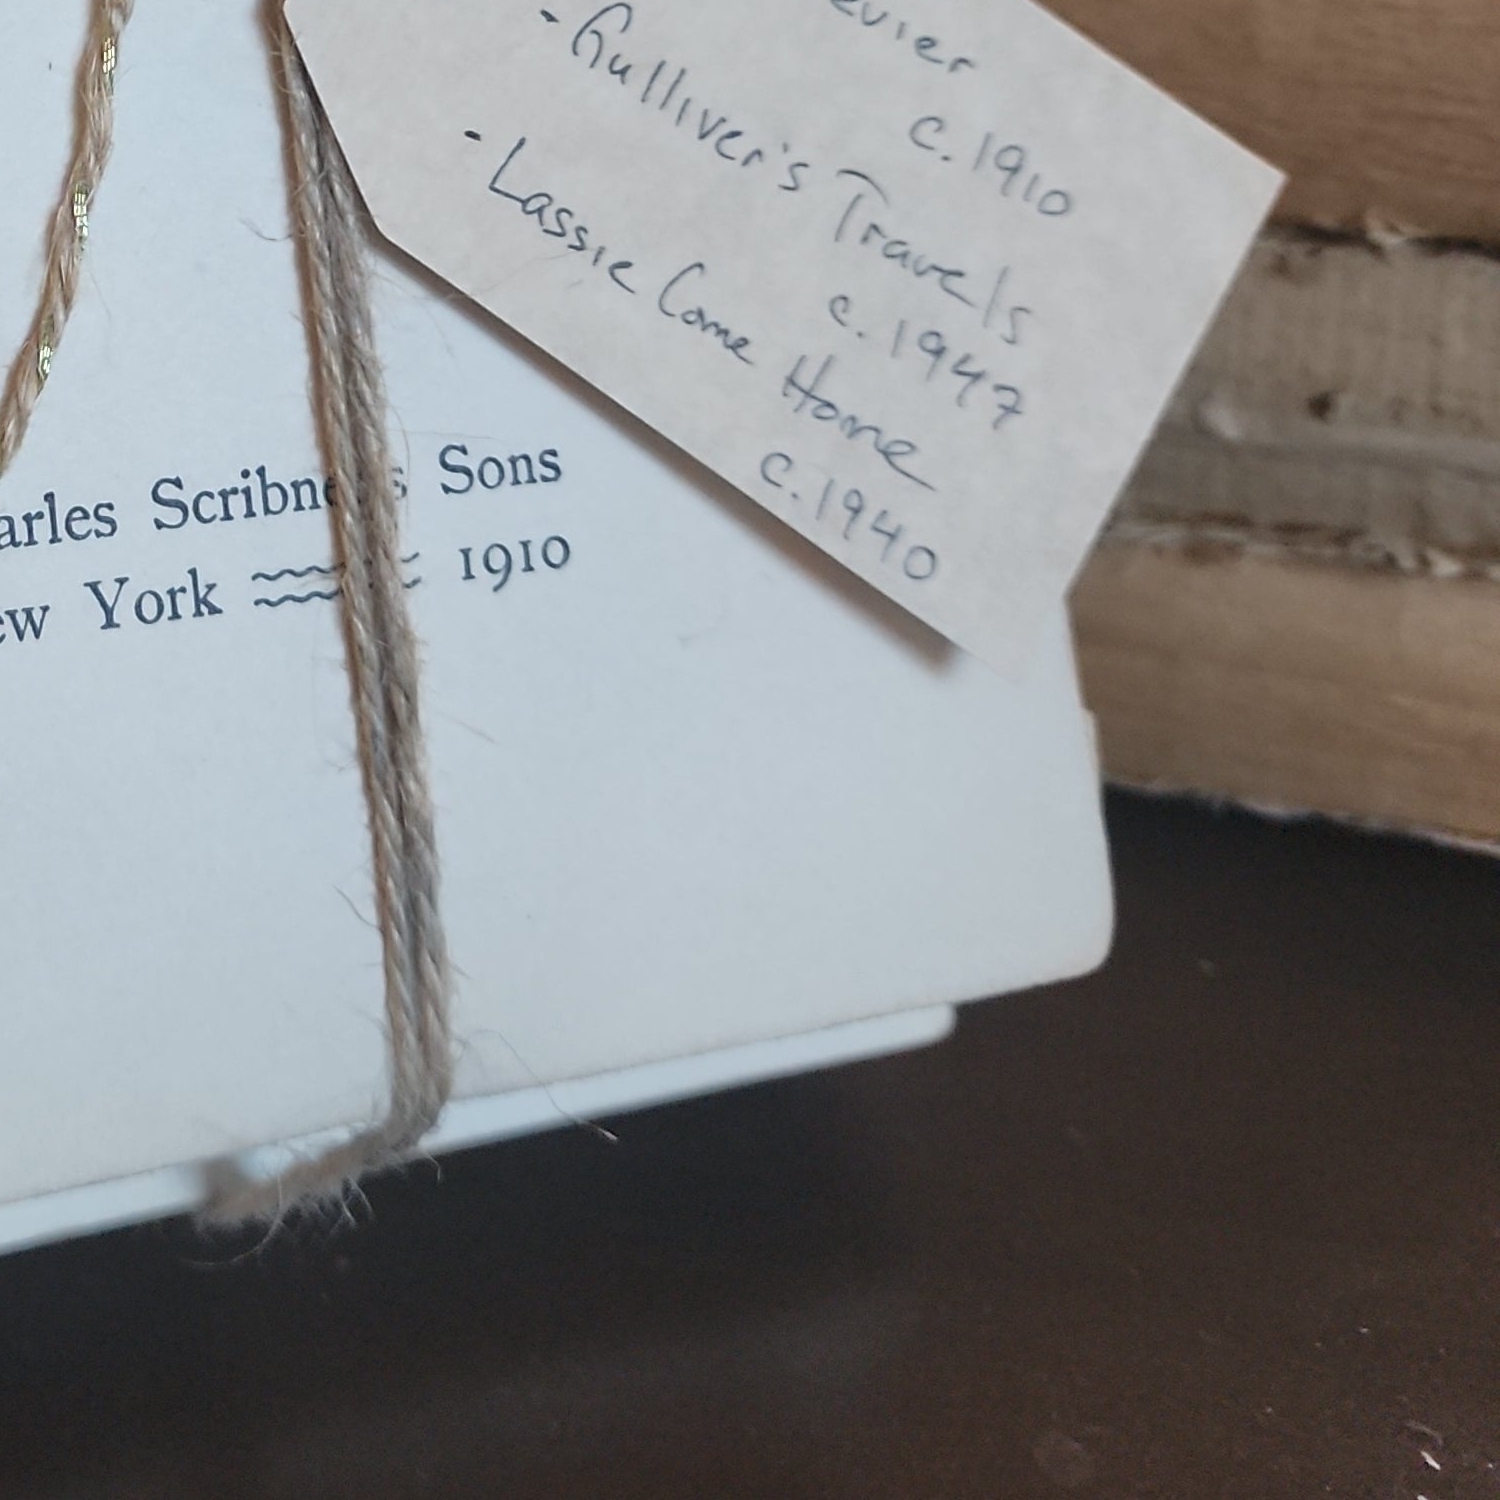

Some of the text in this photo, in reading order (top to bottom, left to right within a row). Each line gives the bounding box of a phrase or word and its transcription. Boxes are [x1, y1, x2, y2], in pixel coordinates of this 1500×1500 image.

[572, 2, 1033, 345] Gulliver's Travels
[489, 137, 937, 491] Lassie Come Home
[83, 566, 224, 631] York
[459, 534, 571, 593] 1910
[151, 463, 408, 533] Scribnes
[437, 443, 563, 499] Sons
